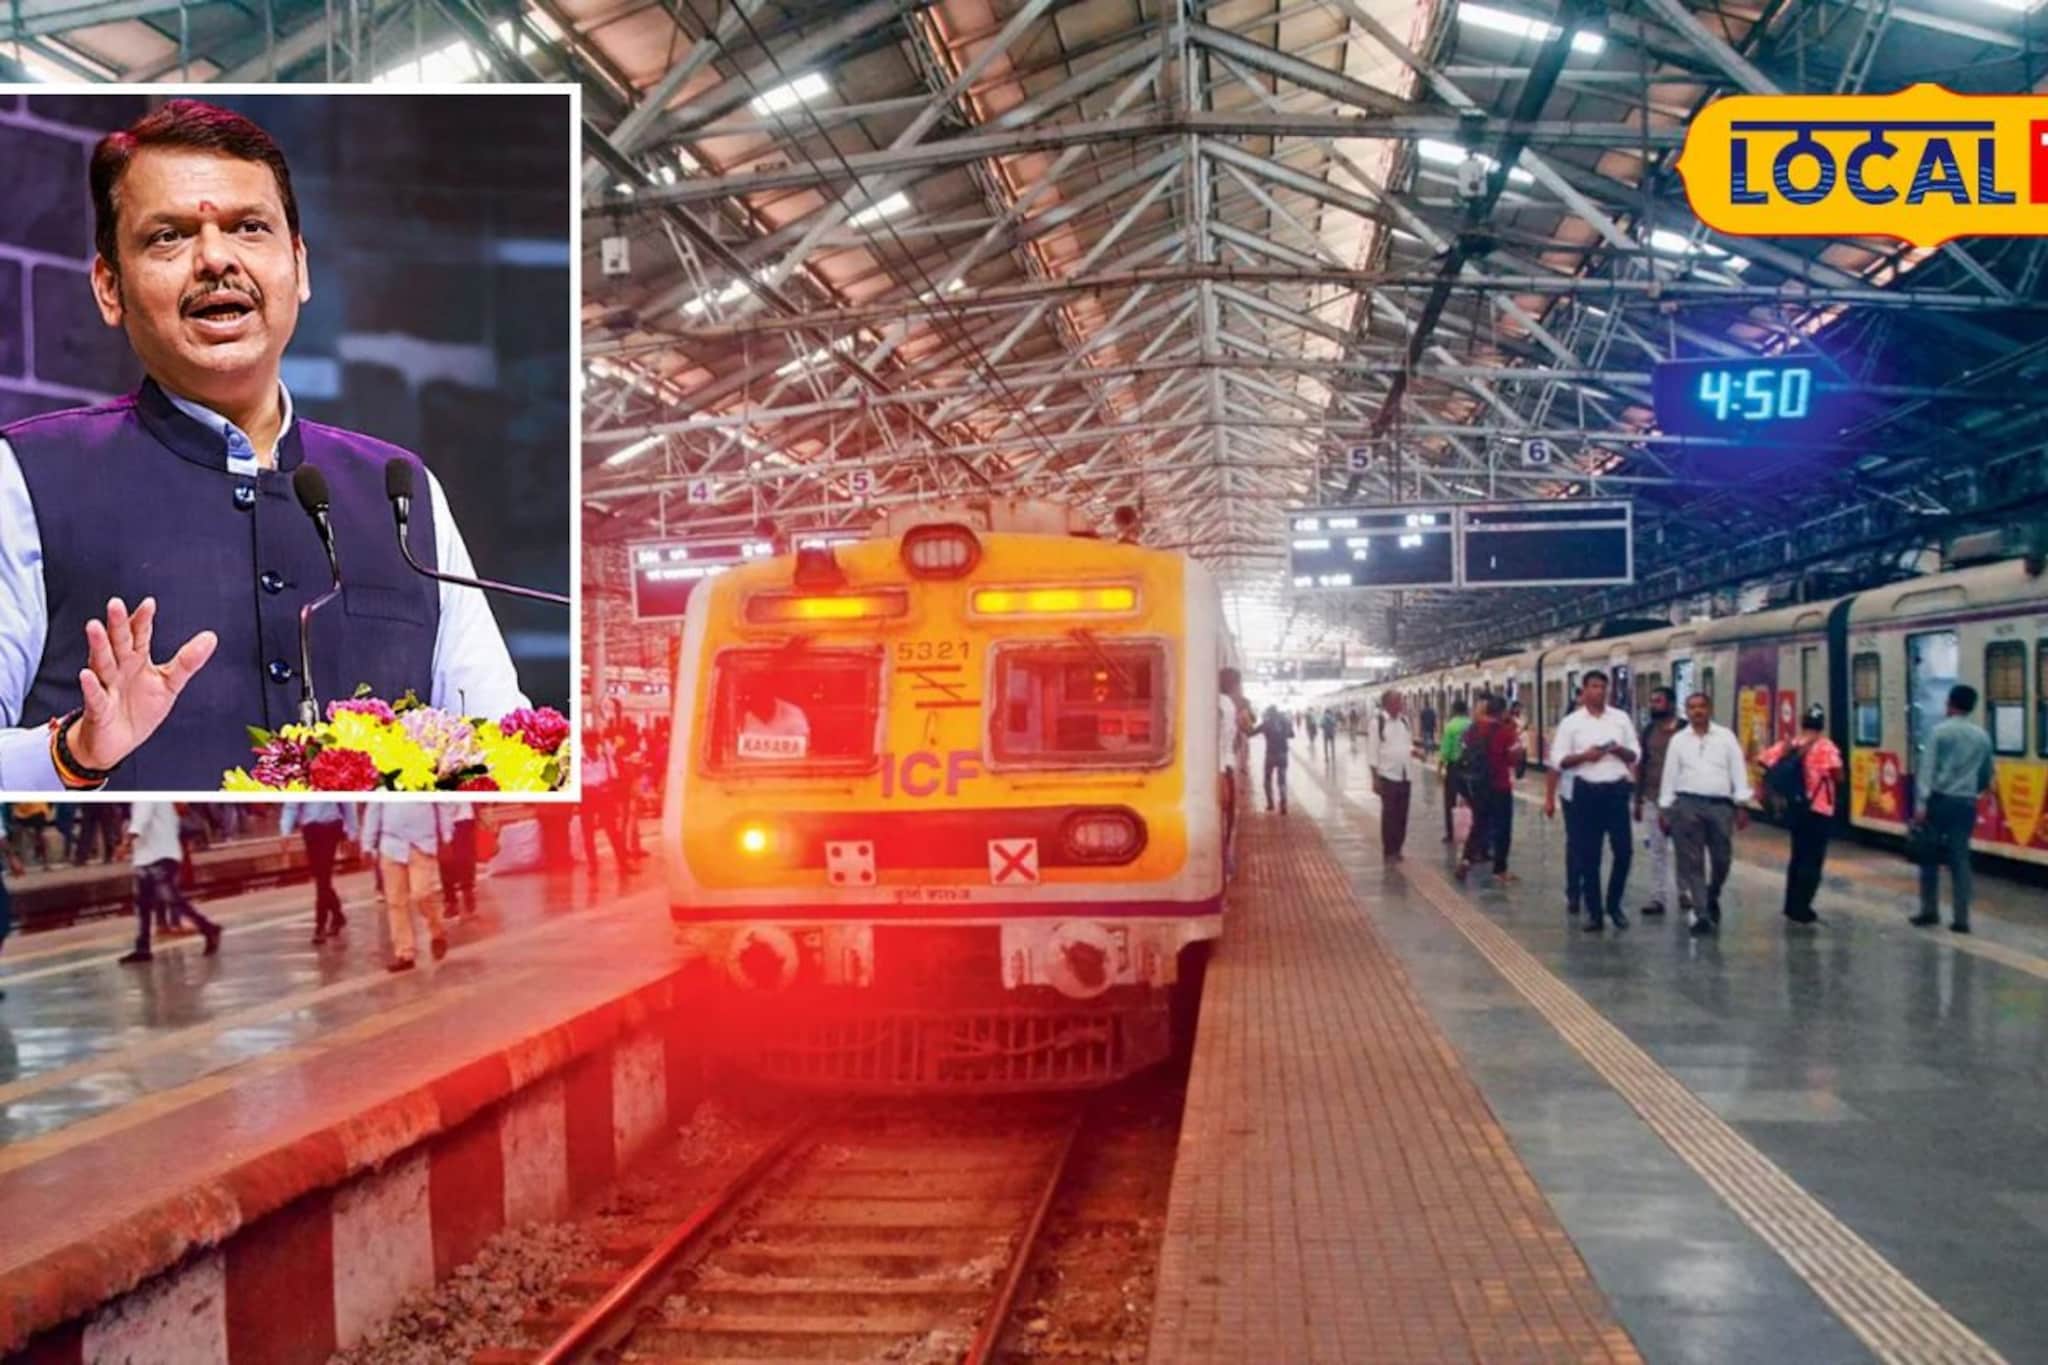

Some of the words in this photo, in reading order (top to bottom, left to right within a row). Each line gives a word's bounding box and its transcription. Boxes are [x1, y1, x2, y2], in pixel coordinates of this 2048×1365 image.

[1699, 368, 1811, 420] 4:50
[1352, 449, 1368, 468] 5
[1528, 441, 1546, 462] 6
[692, 482, 708, 500] 4
[853, 472, 869, 491] 5
[898, 641, 969, 660] 5321
[882, 751, 979, 798] ICF
